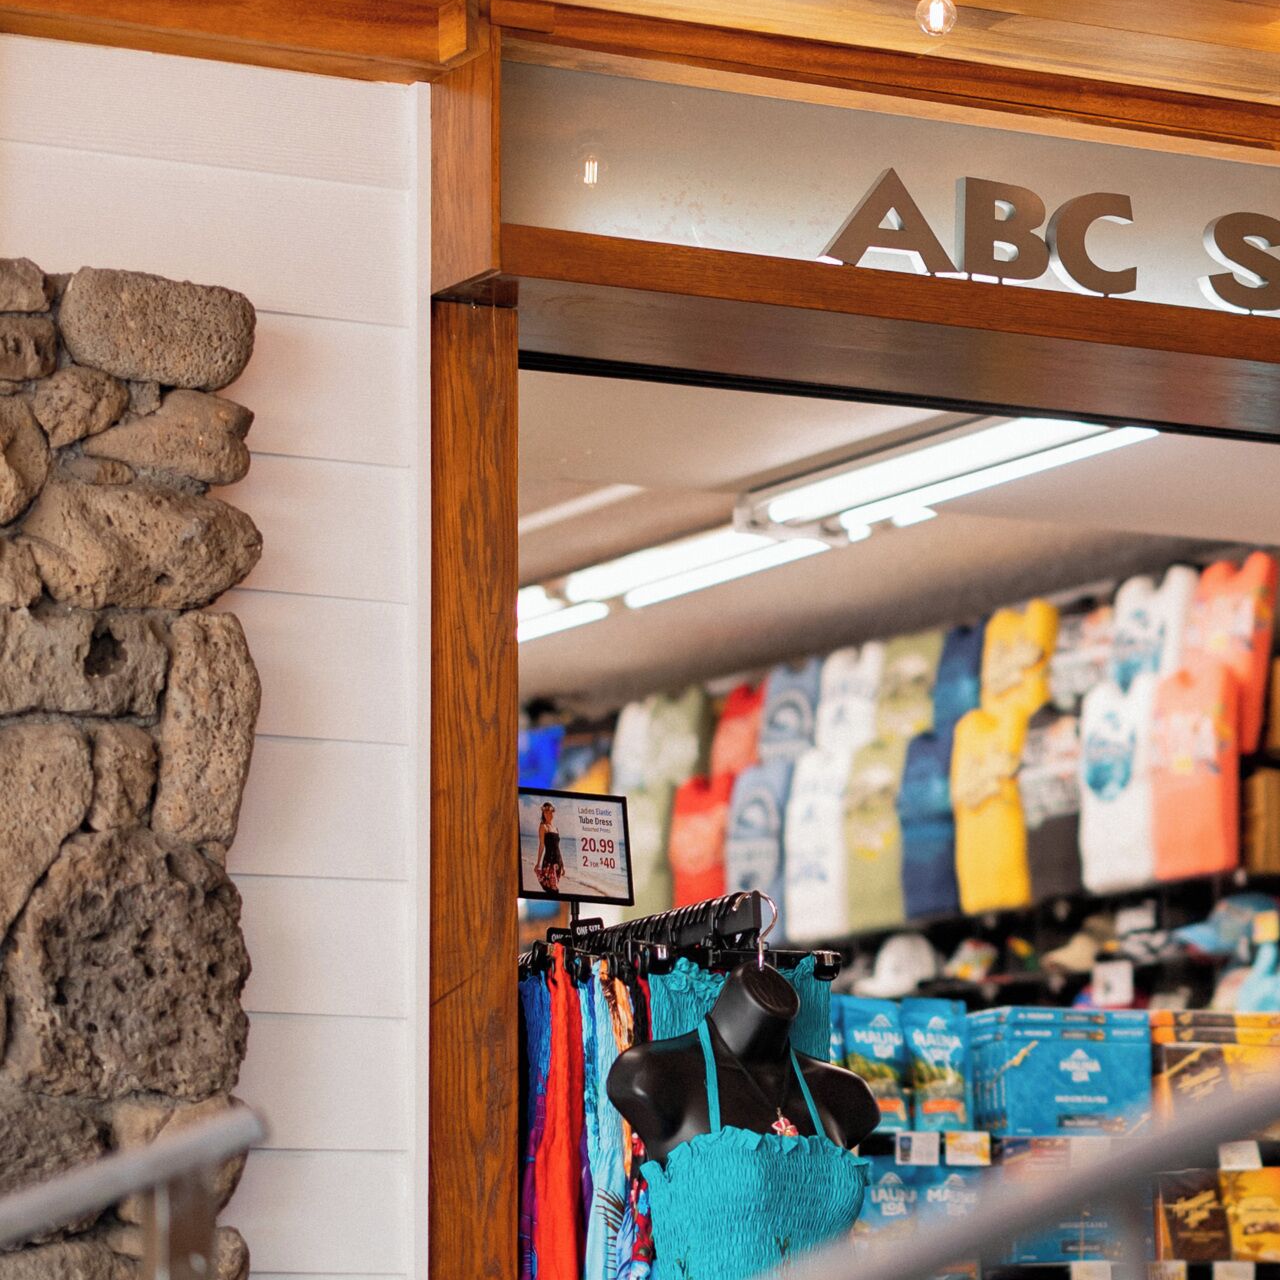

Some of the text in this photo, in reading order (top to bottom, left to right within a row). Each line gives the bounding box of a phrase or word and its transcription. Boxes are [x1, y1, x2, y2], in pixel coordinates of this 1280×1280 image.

[817, 167, 1137, 296] ABC
[578, 807, 595, 815] Ladies
[579, 816, 613, 826] Tube Dress
[581, 837, 614, 854] 20.99
[583, 856, 589, 867] 2
[600, 857, 616, 869] $40
